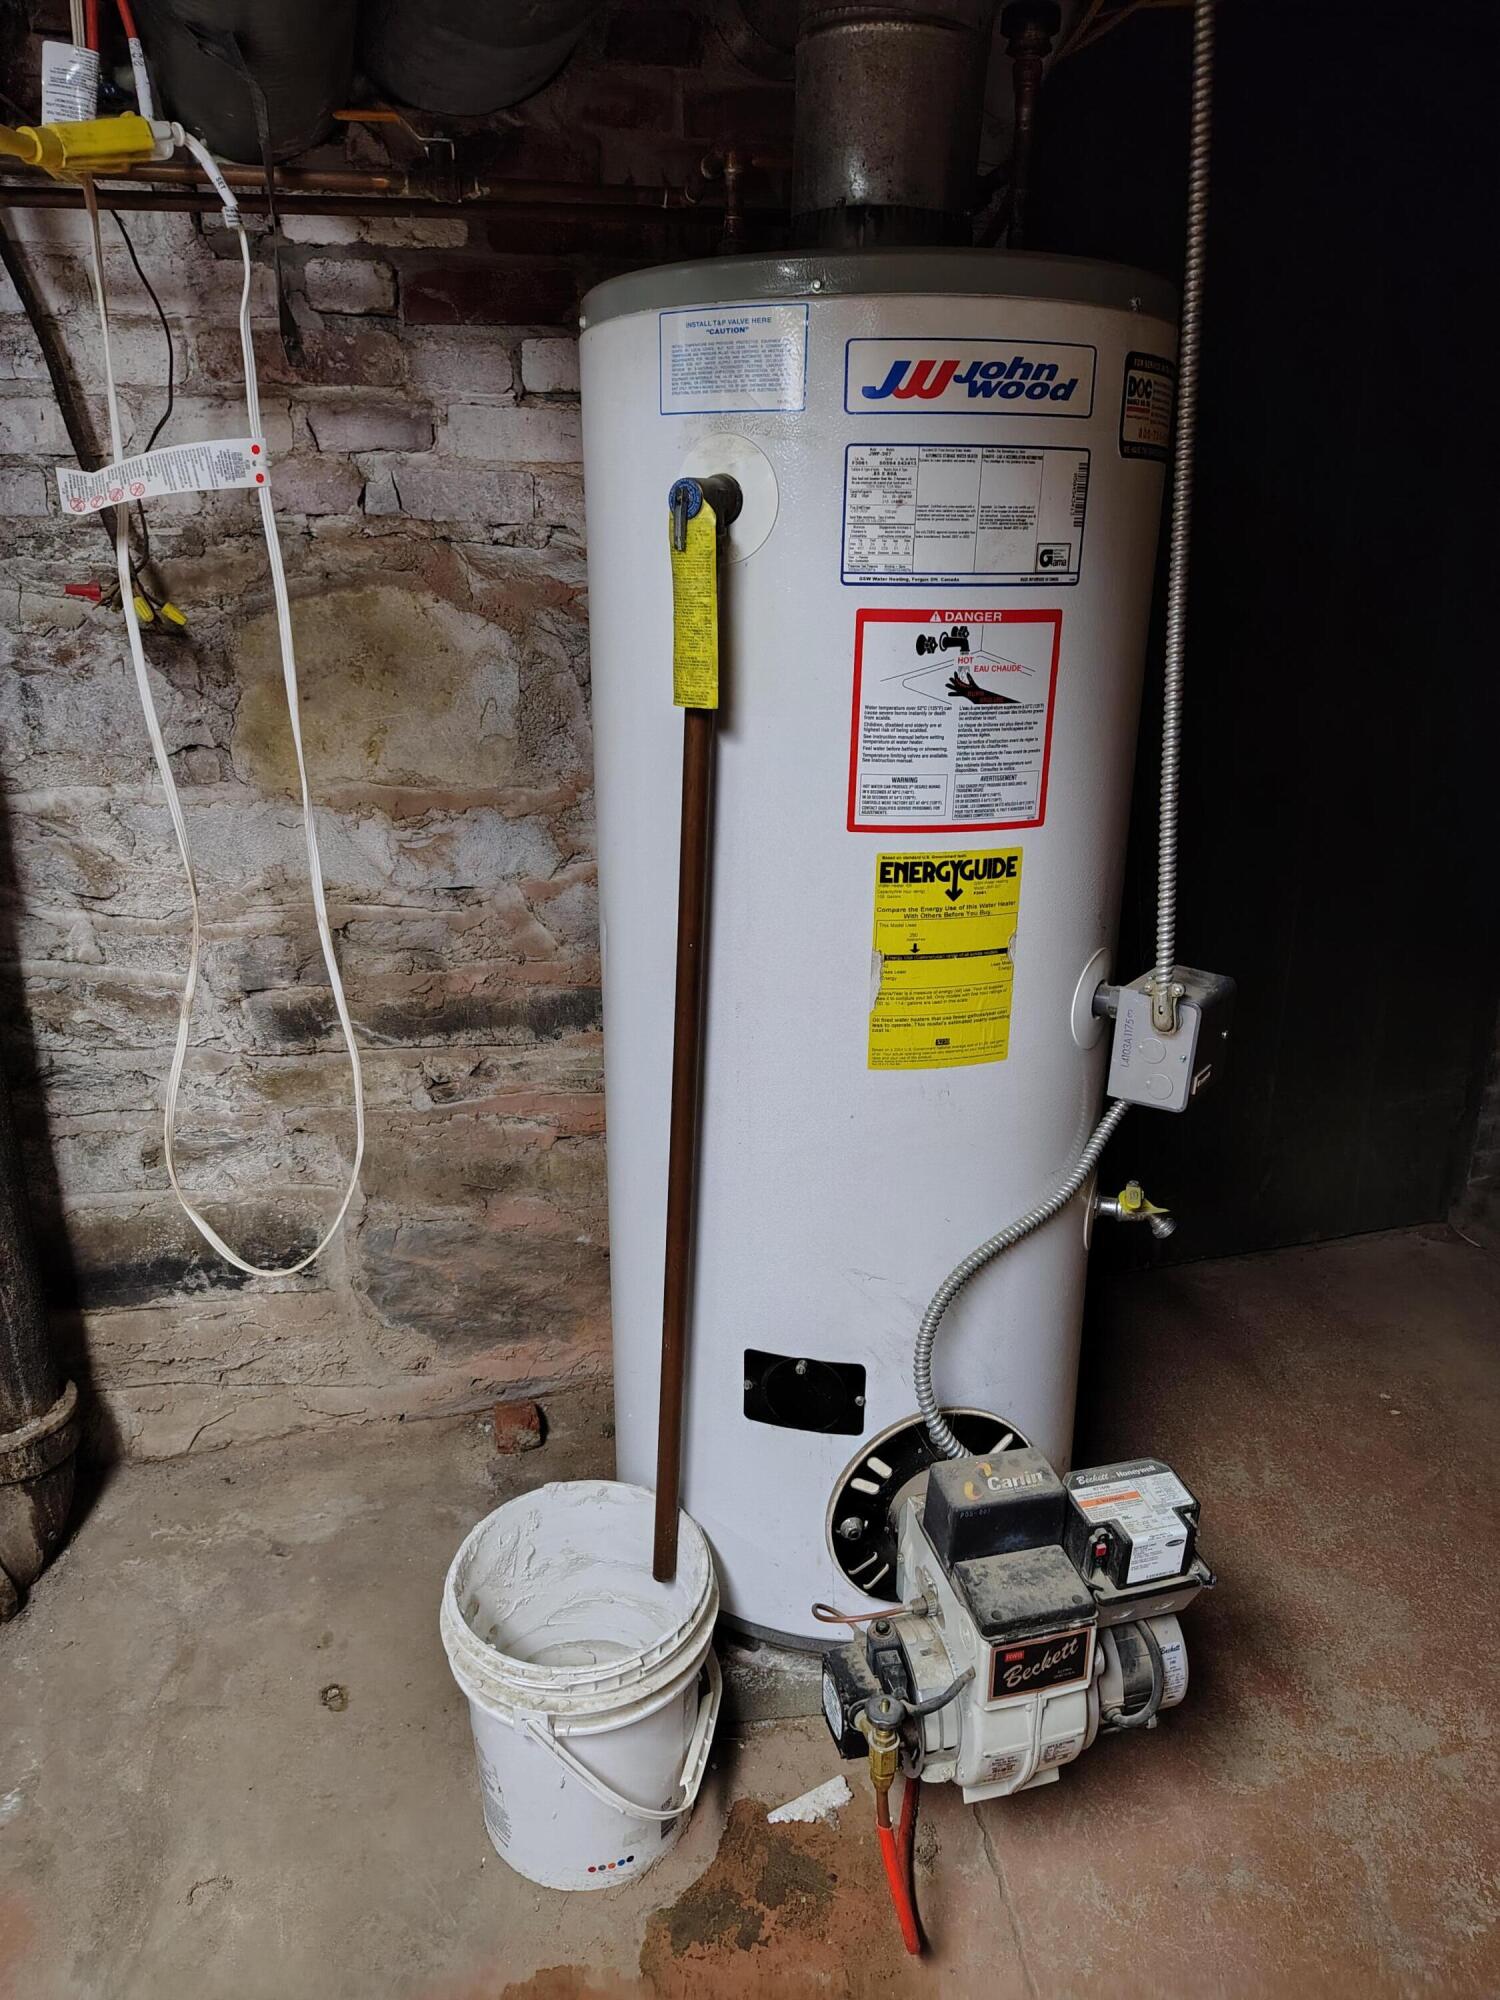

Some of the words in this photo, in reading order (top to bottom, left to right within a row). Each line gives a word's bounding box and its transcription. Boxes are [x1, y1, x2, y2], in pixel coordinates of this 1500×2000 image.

[706, 326, 749, 335] "CAUTION"
[945, 612, 1002, 622] DANGER
[880, 856, 1018, 884] ENERGYGUIDE
[987, 1470, 1043, 1491] Carlin
[1076, 1473, 1110, 1485] Beckett
[1115, 1465, 1156, 1478] Honeywell
[1003, 1638, 1079, 1688] Beckett
